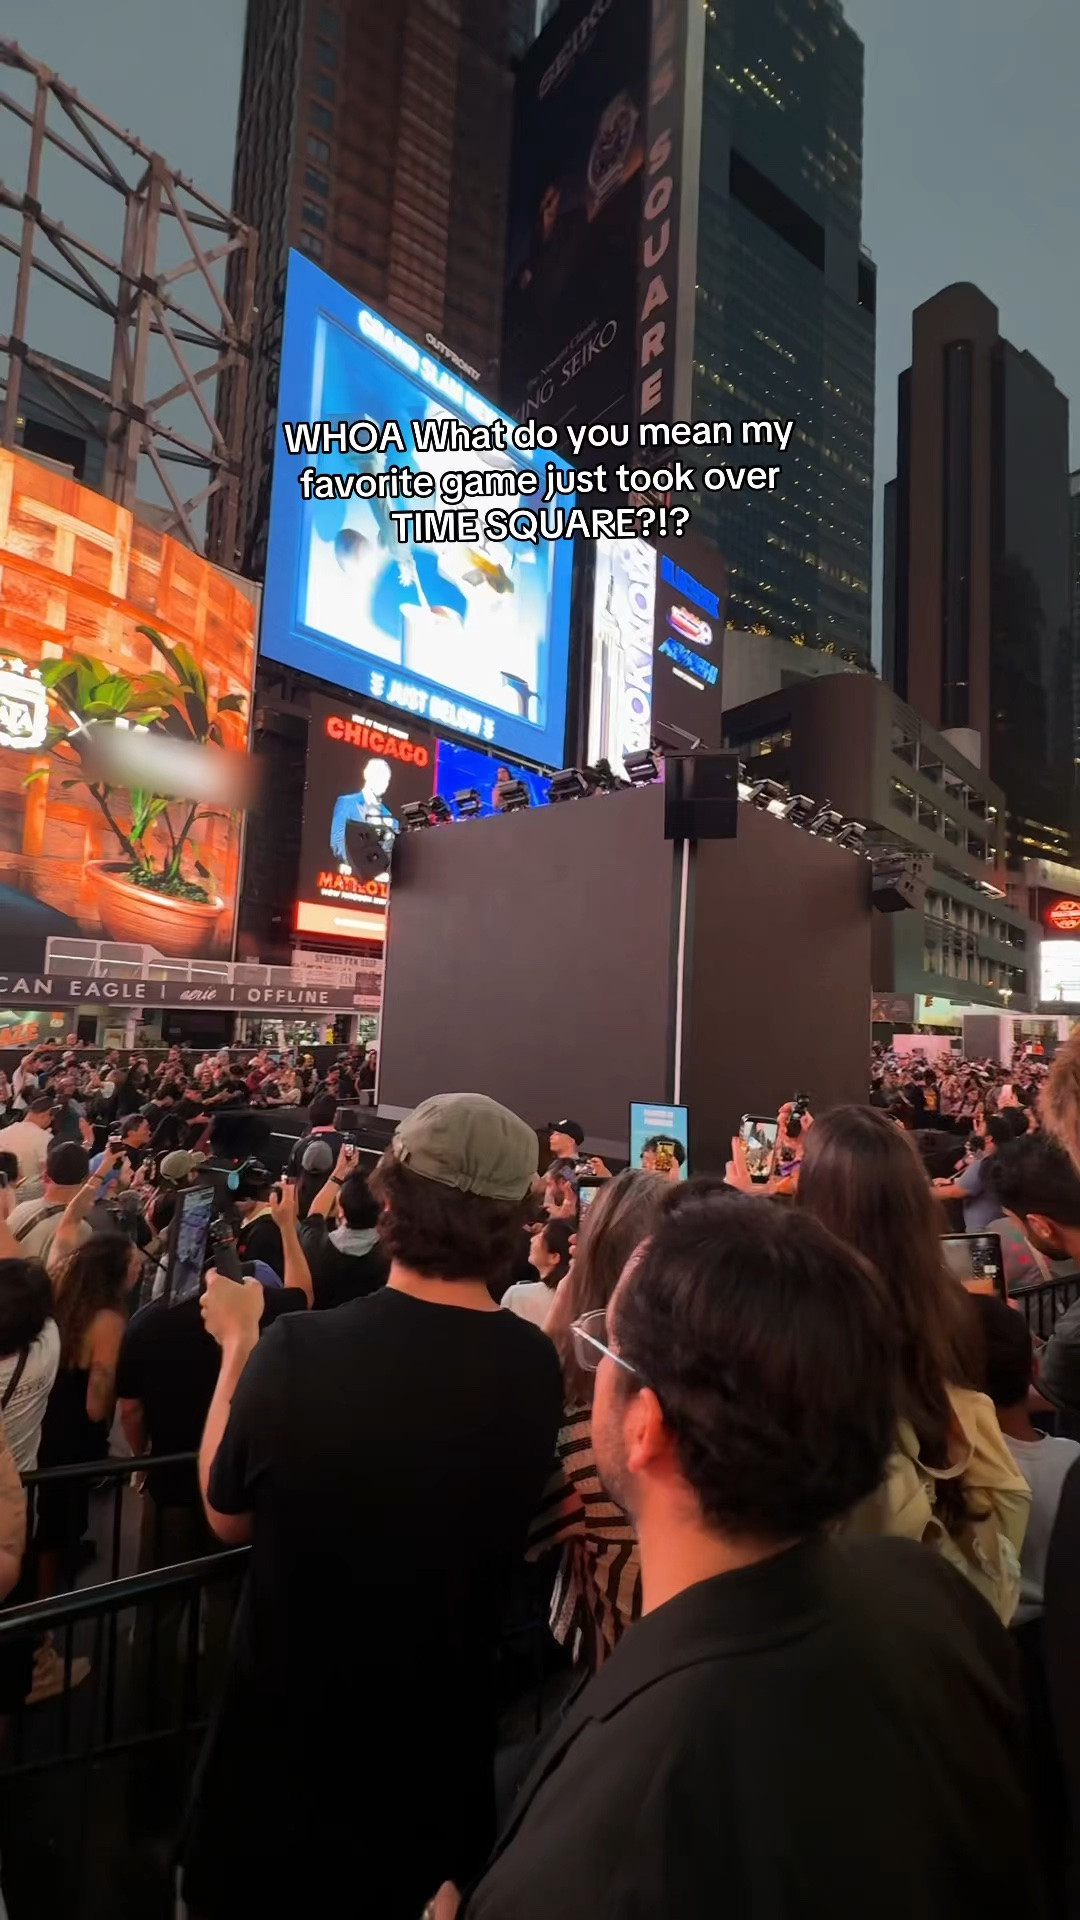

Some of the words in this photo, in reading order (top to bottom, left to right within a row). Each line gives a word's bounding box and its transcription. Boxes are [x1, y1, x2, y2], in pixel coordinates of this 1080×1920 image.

[561, 319, 617, 387] SEIKO
[326, 715, 429, 768] CHICAGO
[69, 980, 146, 999] EAGLE
[247, 987, 329, 1004] OFFLINE
